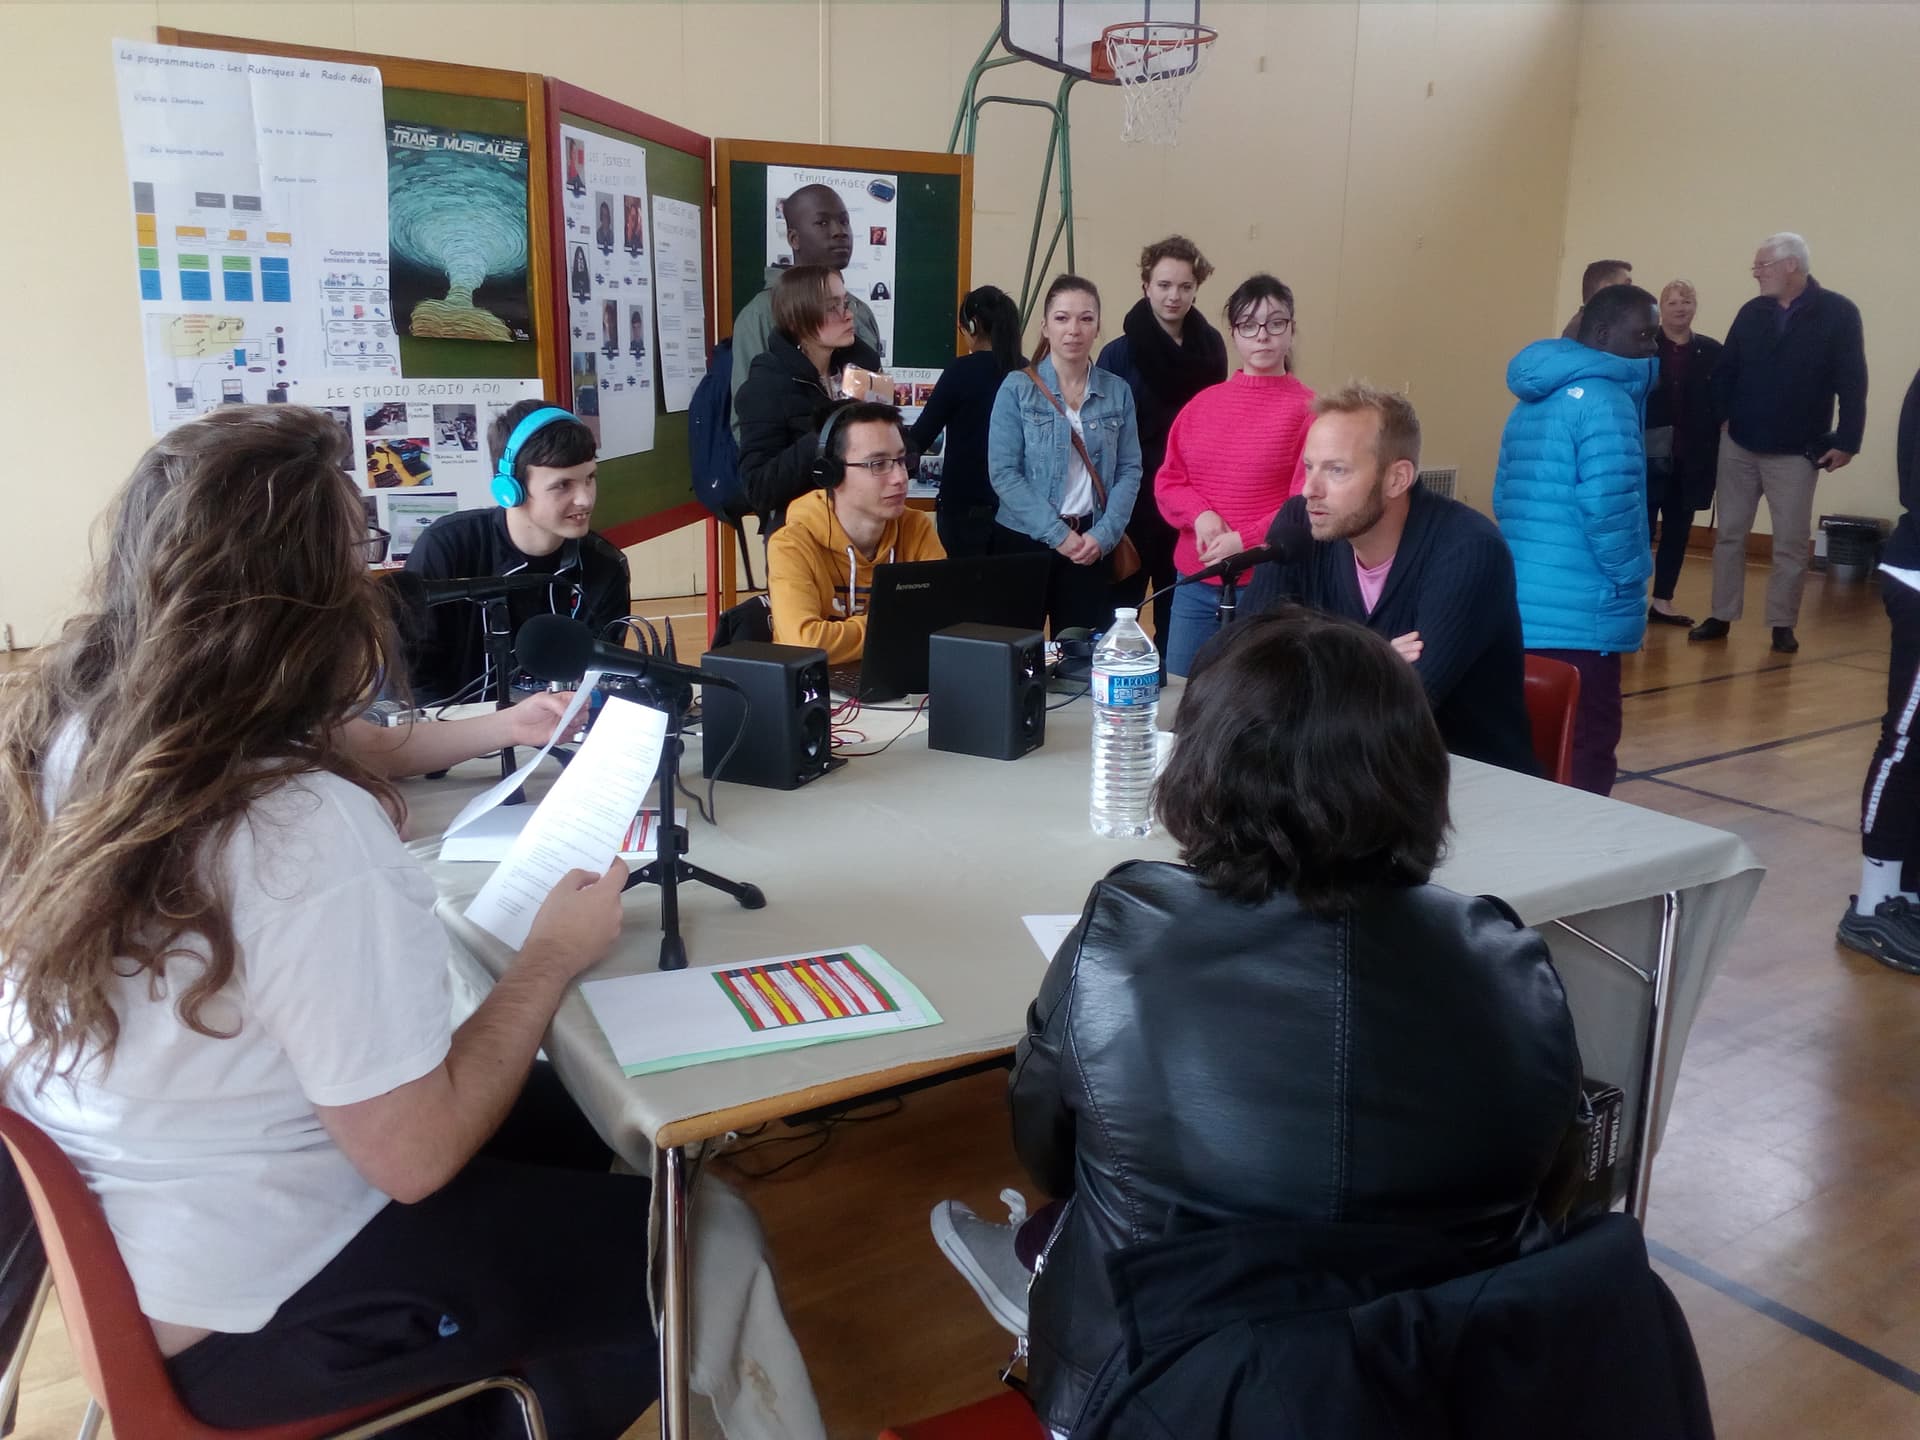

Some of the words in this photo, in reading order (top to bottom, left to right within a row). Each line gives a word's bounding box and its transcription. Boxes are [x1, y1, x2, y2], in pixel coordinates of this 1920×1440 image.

[137, 54, 216, 70] programmation
[227, 62, 243, 73] Les
[247, 64, 295, 78] Rubriques
[299, 69, 311, 79] de
[320, 70, 347, 82] Radio
[392, 129, 438, 148] TRANS
[443, 138, 522, 158] MUSICALES
[327, 387, 345, 399] LE
[353, 384, 410, 399] STUDIO
[417, 383, 464, 397] RADIO
